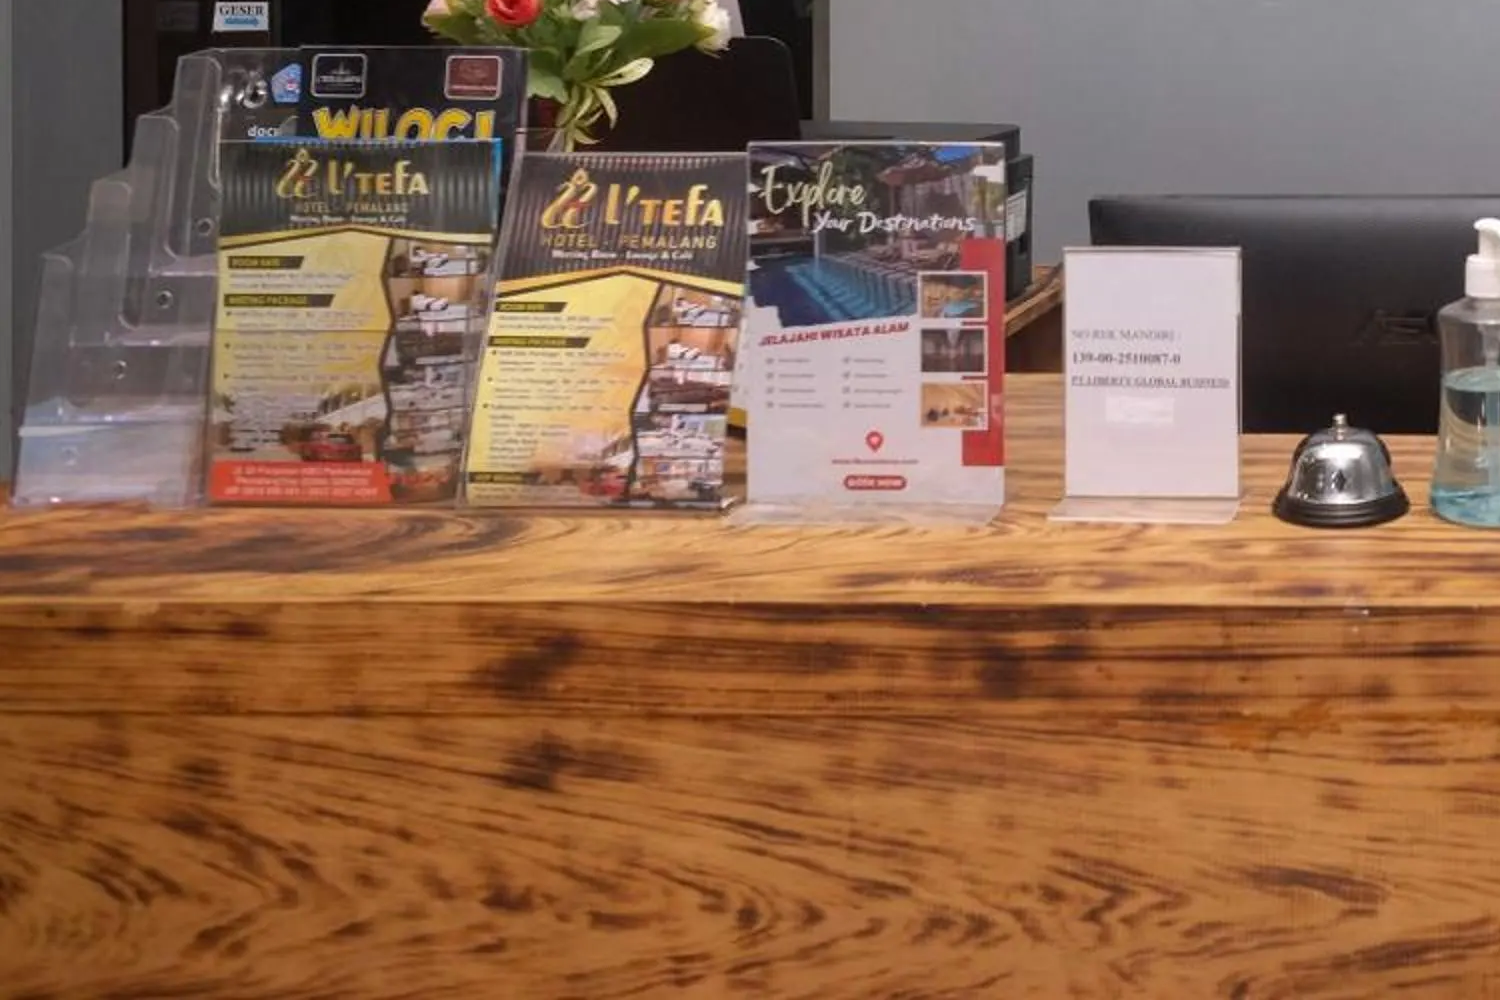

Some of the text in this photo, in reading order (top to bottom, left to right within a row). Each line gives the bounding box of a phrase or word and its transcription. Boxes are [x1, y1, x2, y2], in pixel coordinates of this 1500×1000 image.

[218, 4, 265, 17] GESER
[758, 160, 867, 229] Explore
[812, 210, 977, 234] Your Destinations
[541, 234, 597, 248] HOTEL
[618, 234, 718, 249] PEMALANG
[758, 321, 910, 347] JELAJAHI WISATA ALAM
